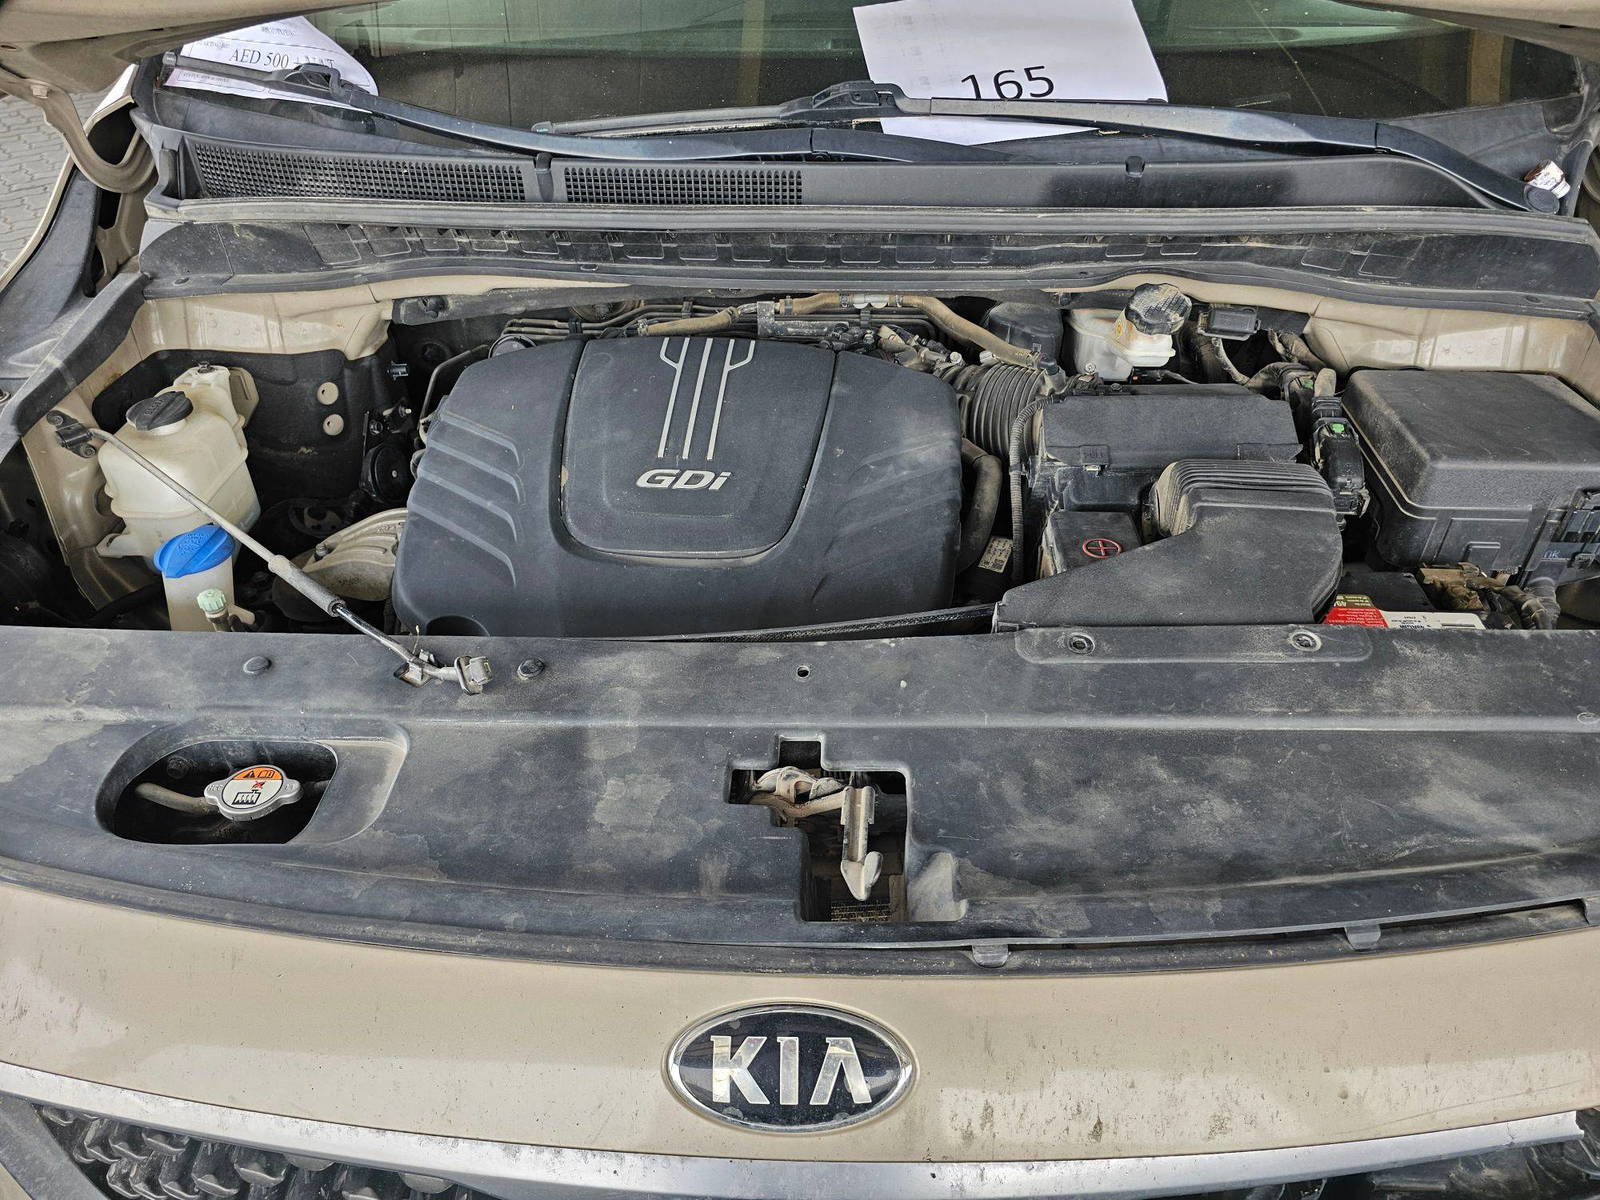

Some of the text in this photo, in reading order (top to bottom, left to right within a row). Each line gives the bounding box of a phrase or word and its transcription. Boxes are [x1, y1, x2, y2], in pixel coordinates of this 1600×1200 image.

[229, 48, 261, 64] AED
[264, 52, 290, 69] 500
[961, 65, 1055, 100] 165
[635, 468, 733, 491] GDi
[710, 1035, 873, 1105] KIA
